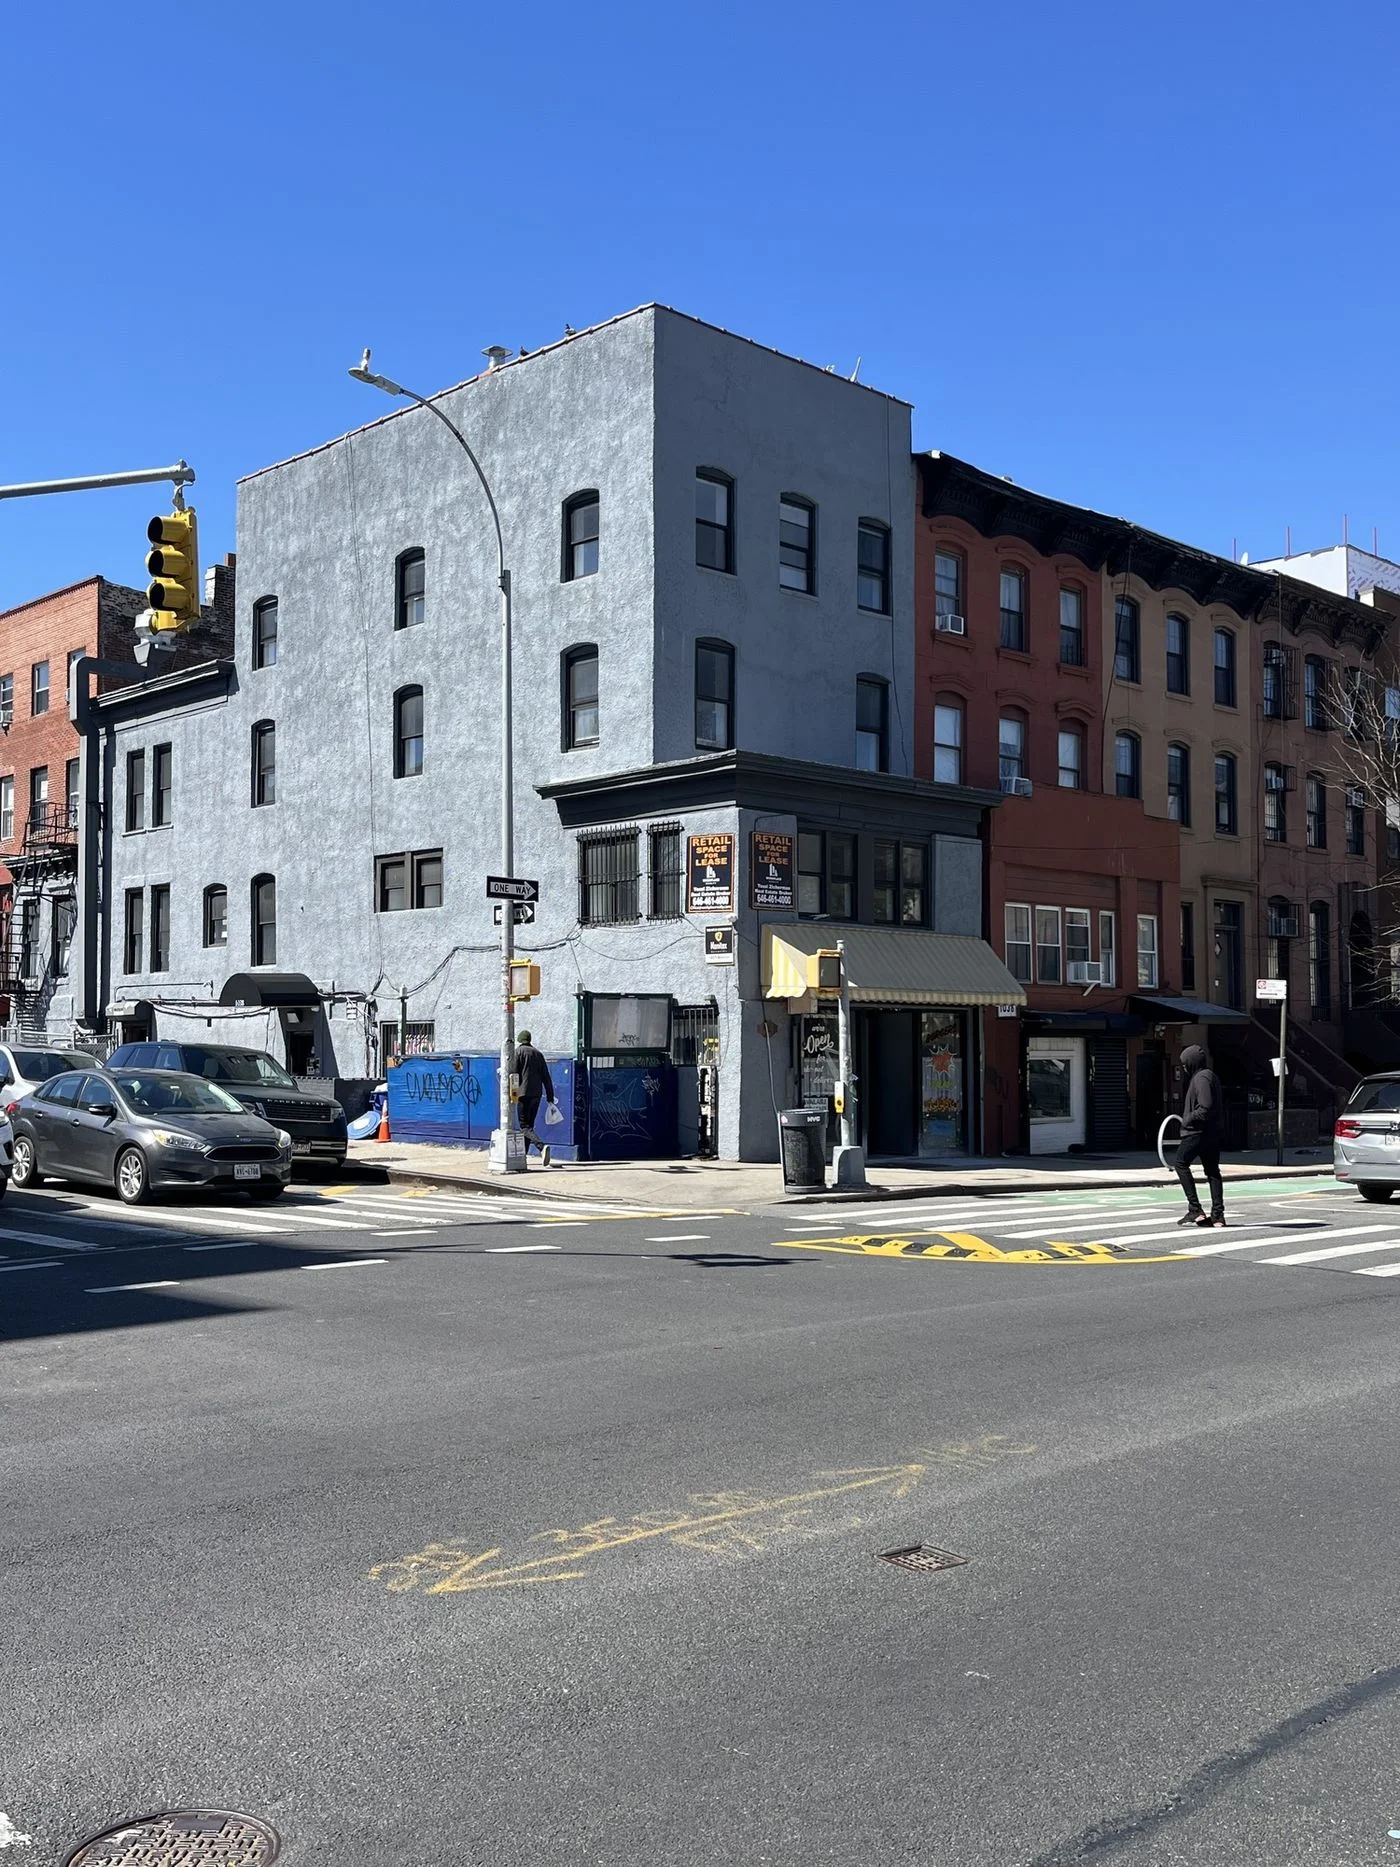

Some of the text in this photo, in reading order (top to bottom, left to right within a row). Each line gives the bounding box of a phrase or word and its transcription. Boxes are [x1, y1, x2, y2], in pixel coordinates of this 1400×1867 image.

[692, 836, 731, 846] RETAIL
[755, 834, 791, 846] RETAIL
[695, 845, 727, 854] SPACE
[695, 857, 727, 866] LEASE
[759, 857, 788, 865] LEASE
[494, 883, 531, 895] ONE WAY
[757, 894, 791, 904] 646-461-4000
[804, 1033, 834, 1054] Open
